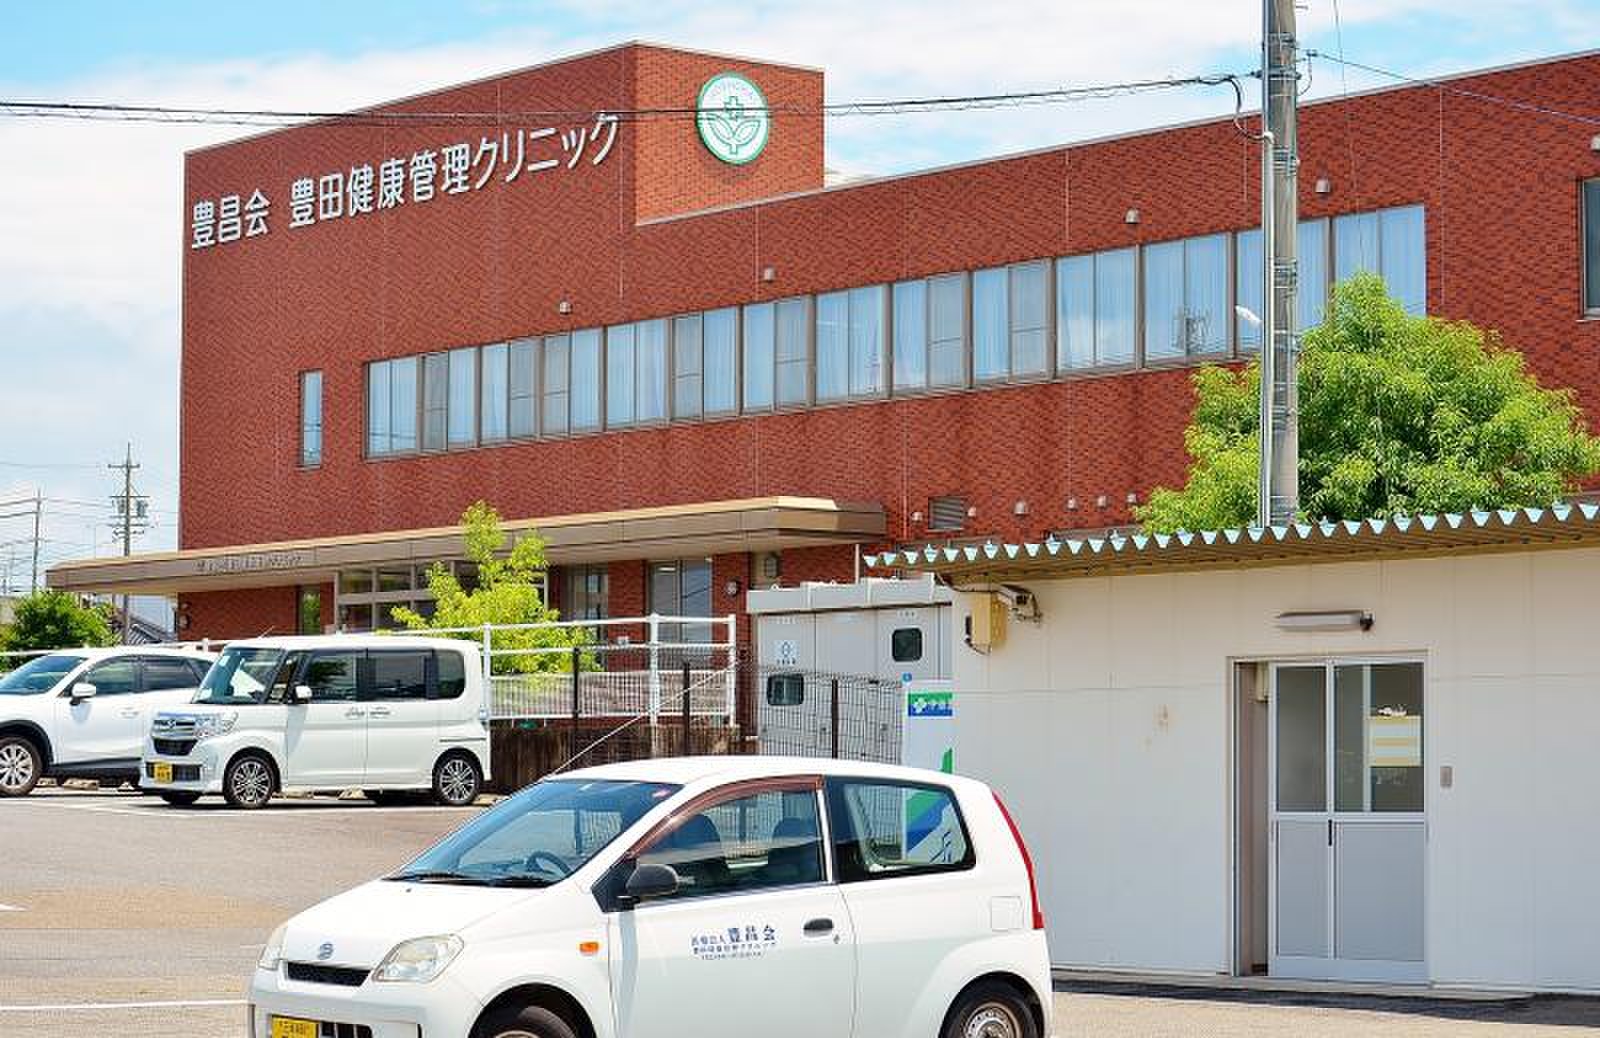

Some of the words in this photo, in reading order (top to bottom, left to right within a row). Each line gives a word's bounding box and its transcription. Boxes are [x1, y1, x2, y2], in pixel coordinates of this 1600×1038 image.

[191, 187, 271, 248] 豊昌会
[289, 111, 619, 228] 豊田健康管理クリニック
